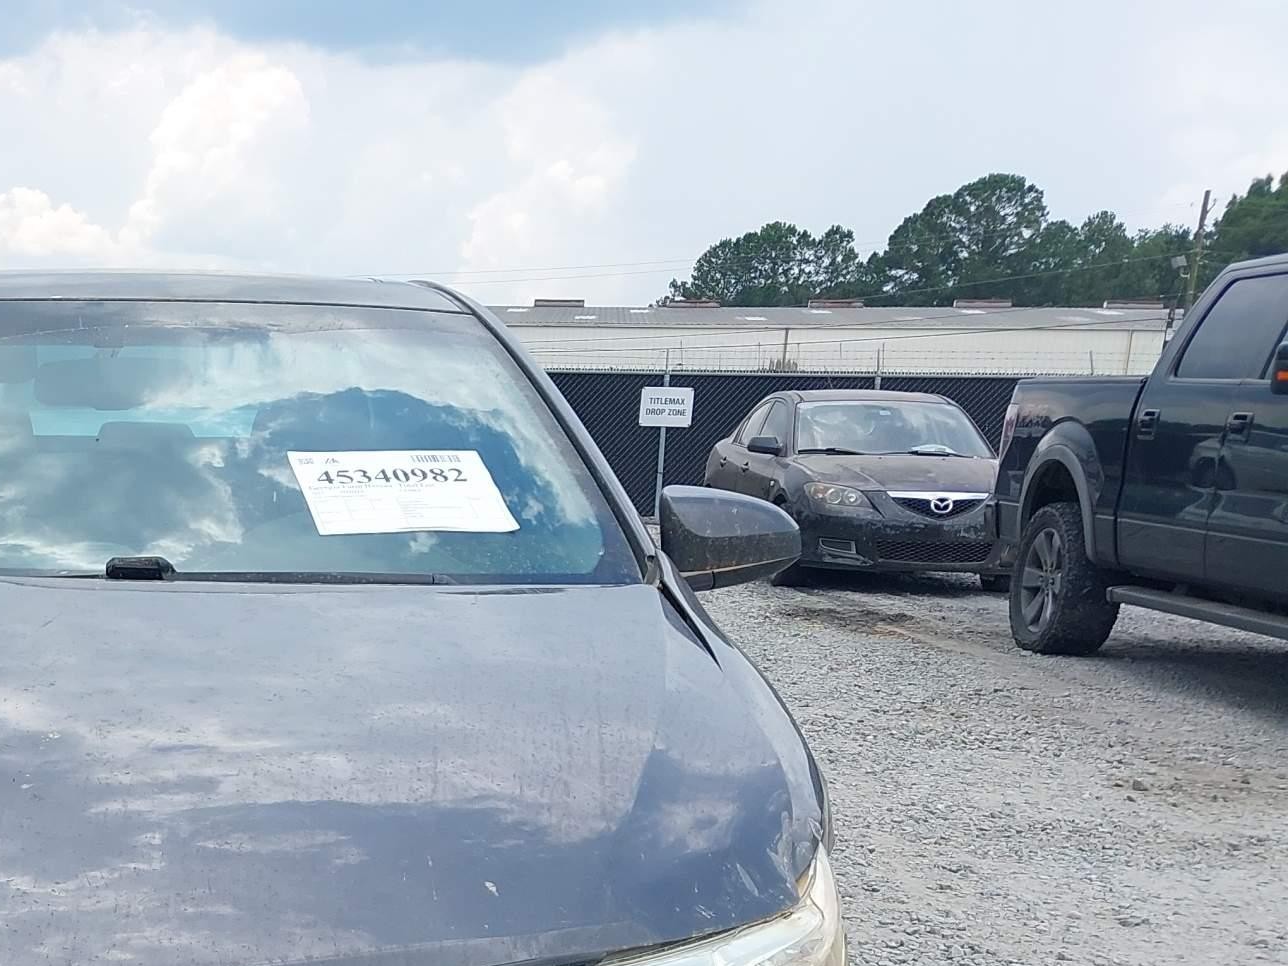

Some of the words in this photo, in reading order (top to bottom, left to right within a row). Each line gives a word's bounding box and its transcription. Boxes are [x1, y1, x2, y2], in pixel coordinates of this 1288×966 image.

[649, 397, 685, 405] TITLEMAX
[645, 408, 666, 416] DROP
[667, 408, 687, 417] ZONE
[317, 468, 468, 485] 45340982
